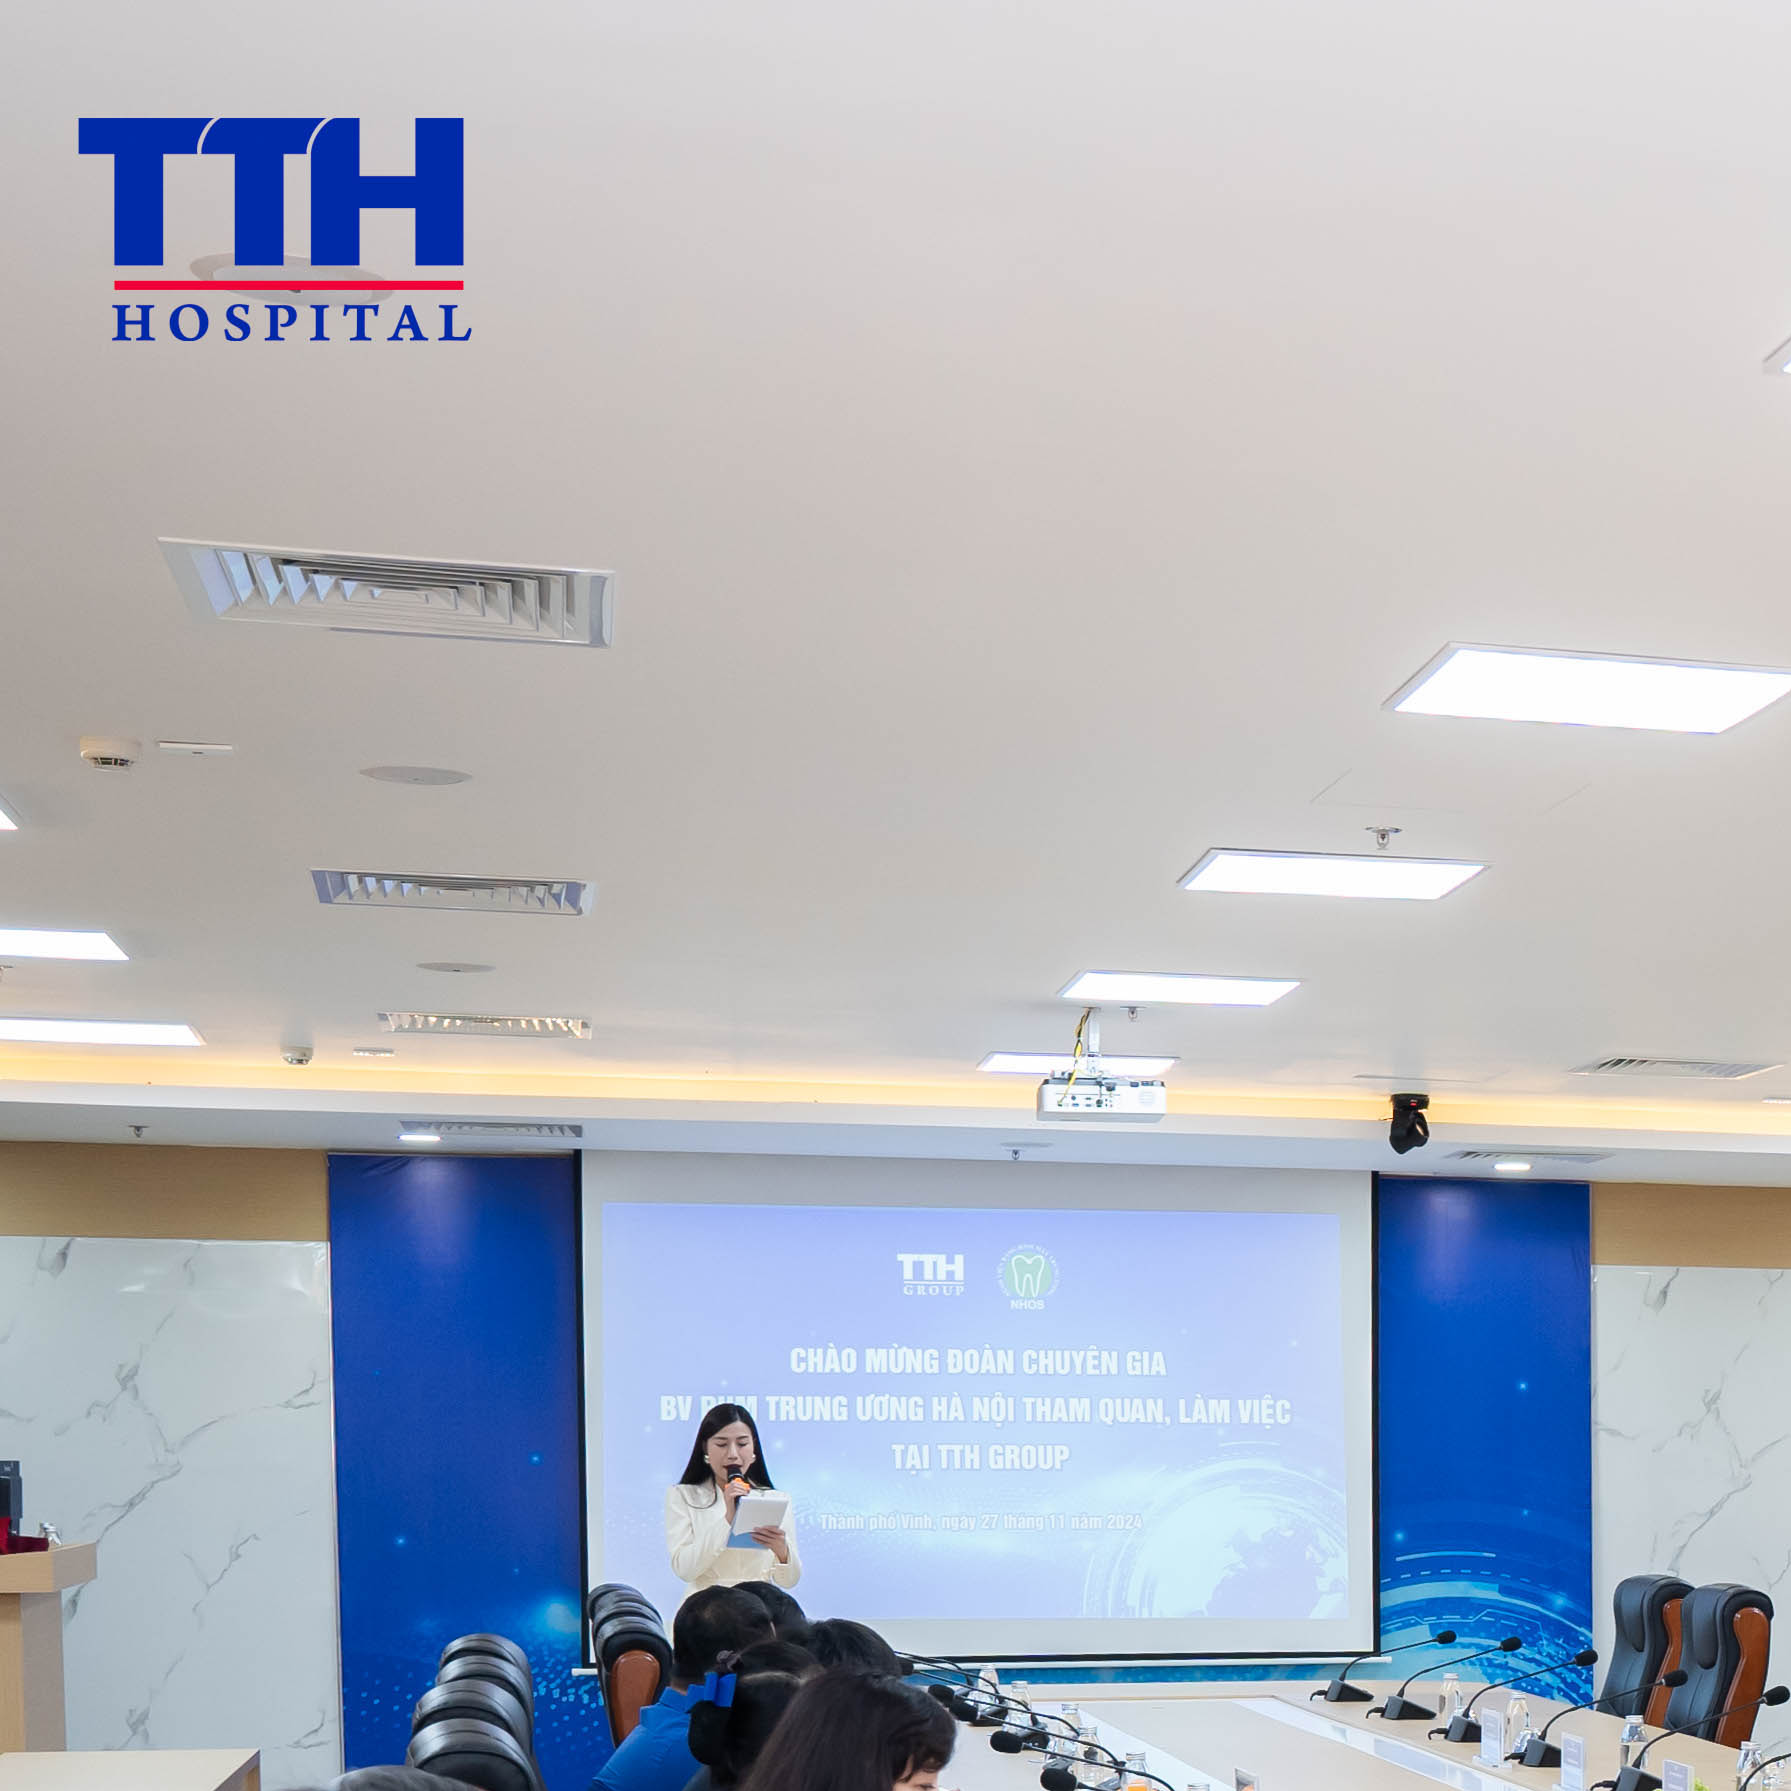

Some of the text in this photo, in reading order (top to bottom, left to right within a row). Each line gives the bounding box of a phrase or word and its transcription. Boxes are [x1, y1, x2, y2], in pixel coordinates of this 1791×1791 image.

[897, 1253, 964, 1280] TTH
[903, 1285, 965, 1296] GROUP
[1010, 1299, 1045, 1309] NHOS
[790, 1343, 1167, 1376] CHÀO MỪNG ĐOÀN CHUYÊN GIA
[660, 1396, 692, 1421] BV
[766, 1396, 848, 1421] TRUNG
[856, 1393, 924, 1422] ƯƠNG
[932, 1392, 965, 1422] HÀ
[973, 1392, 1015, 1427] NỘI
[1023, 1397, 1091, 1423] THAM
[1099, 1398, 1171, 1426] QUAN,
[1179, 1394, 1230, 1424] LÀM
[1238, 1394, 1291, 1429] VIỆC
[891, 1444, 1070, 1475] TẠI TTH GROUP
[820, 1512, 865, 1530] Thành
[869, 1510, 896, 1531] phố
[942, 1512, 976, 1532] ngày
[980, 1514, 999, 1529] 27
[1003, 1512, 1045, 1532] tháng
[1049, 1514, 1065, 1529] 11
[1106, 1514, 1143, 1530] 2024
